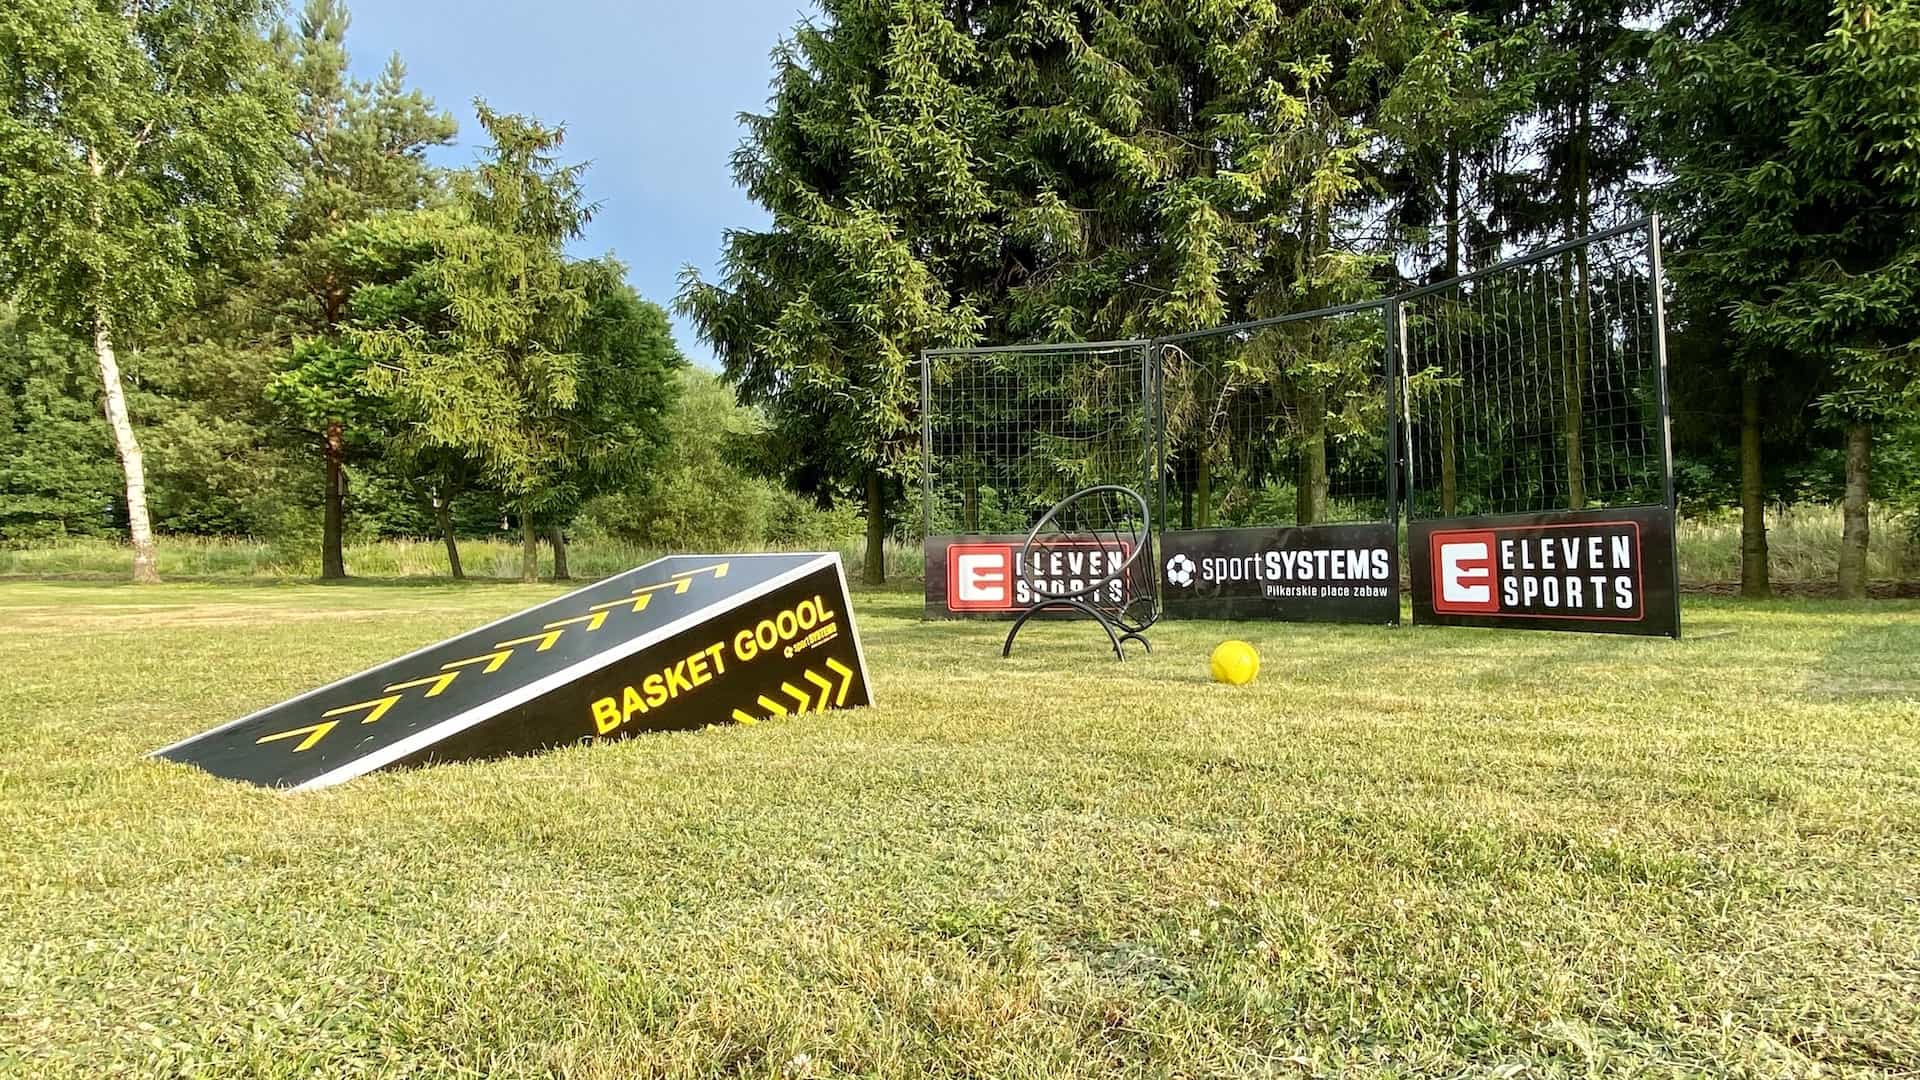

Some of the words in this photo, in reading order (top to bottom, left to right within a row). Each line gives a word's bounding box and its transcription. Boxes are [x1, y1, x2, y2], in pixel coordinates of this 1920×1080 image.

[1202, 549, 1389, 584] sportSYSTEMS
[1502, 536, 1630, 570] ELEVEN
[1320, 585, 1350, 598] place
[1353, 585, 1388, 597] zabaw
[1503, 576, 1633, 609] SPORTS
[591, 642, 725, 735] BASKET
[733, 595, 834, 662] GOOOL
